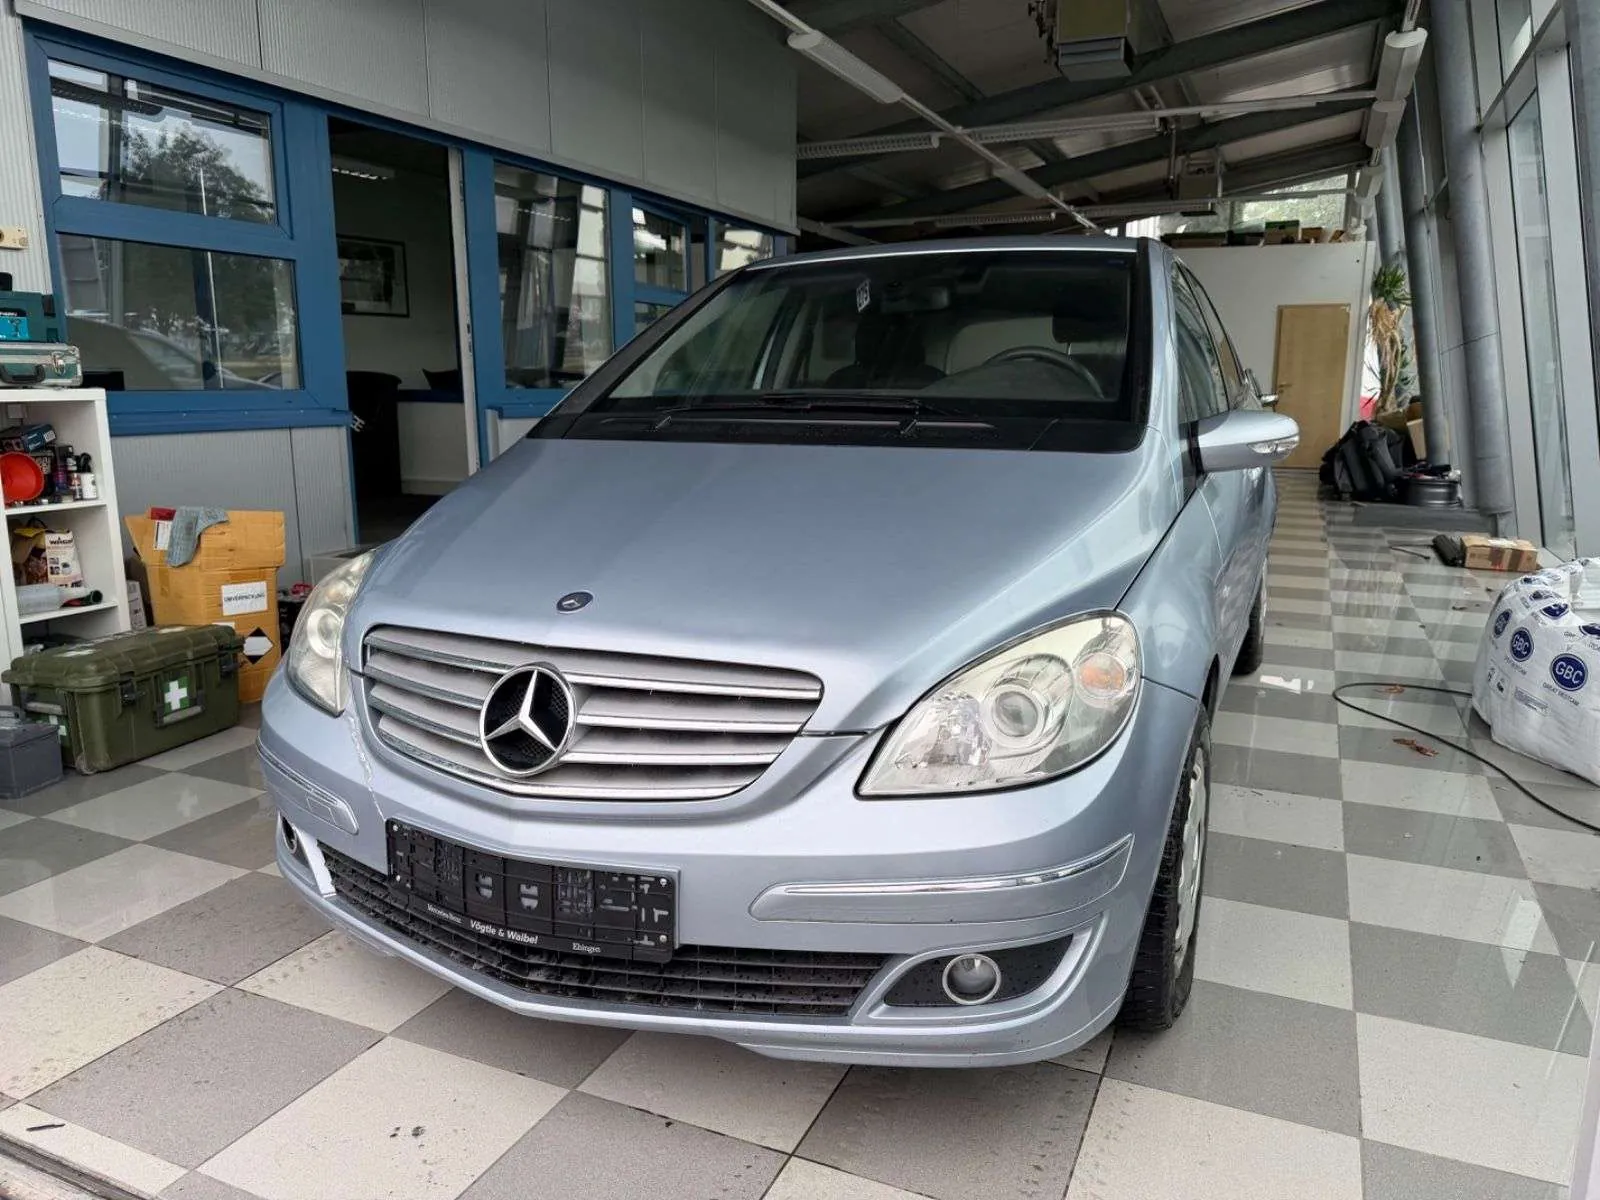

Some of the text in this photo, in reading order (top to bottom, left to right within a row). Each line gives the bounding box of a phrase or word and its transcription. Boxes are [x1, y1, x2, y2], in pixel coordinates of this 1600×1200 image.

[1513, 634, 1529, 655] GBC
[1555, 661, 1583, 684] GBC
[470, 919, 538, 944] Vögtle & Waibel
